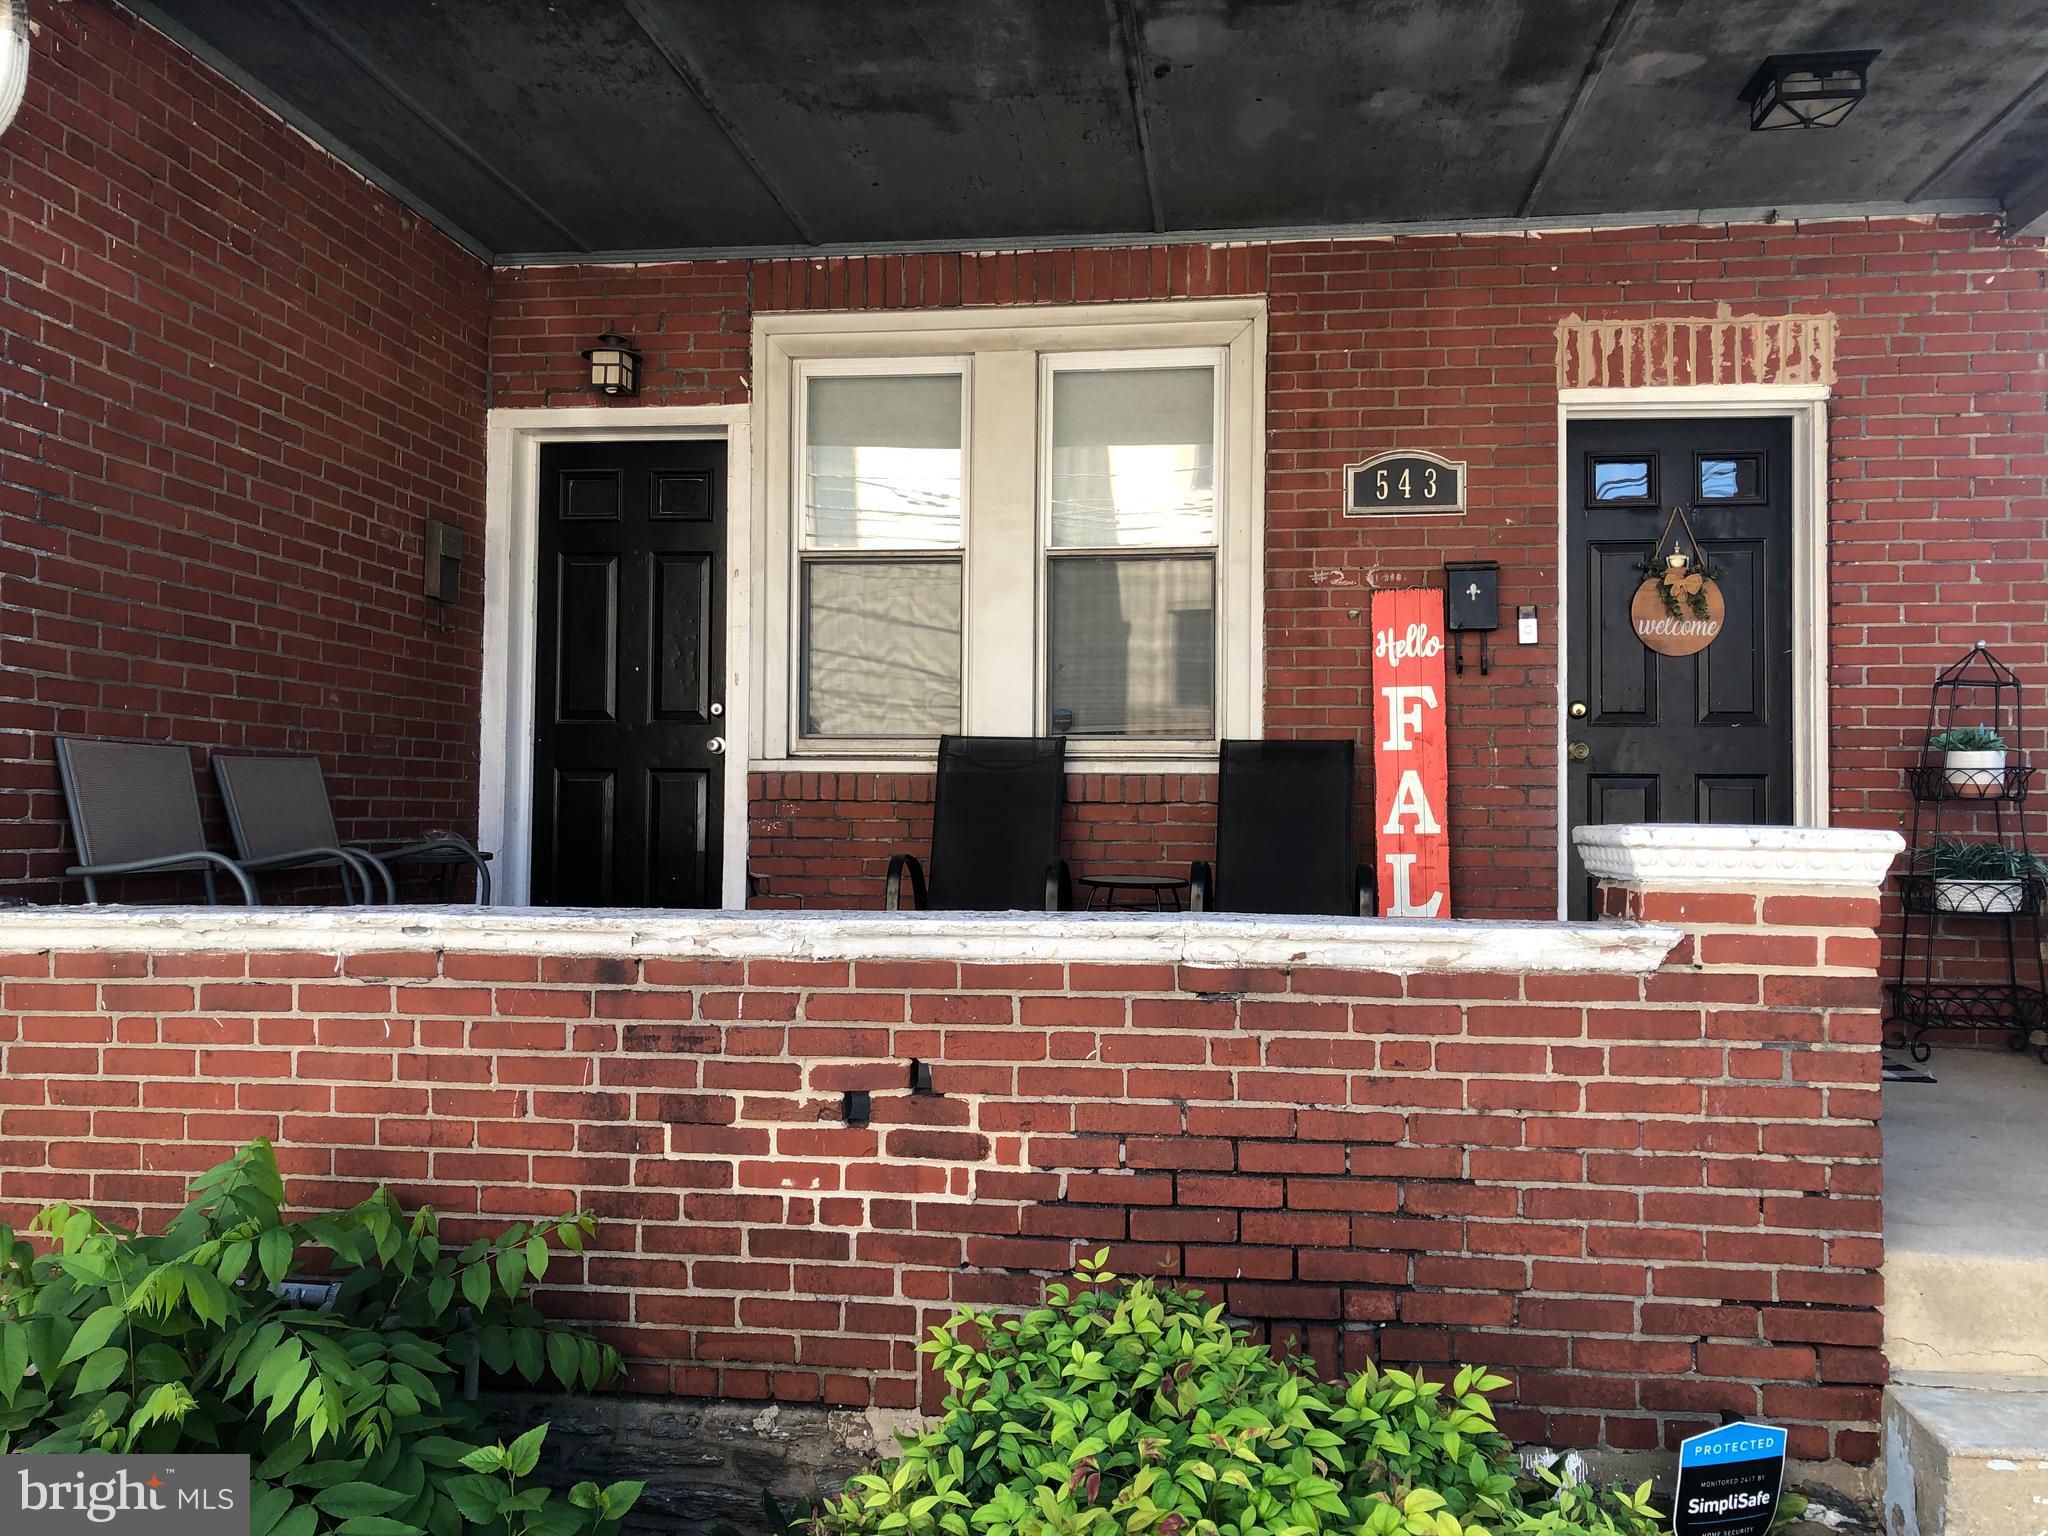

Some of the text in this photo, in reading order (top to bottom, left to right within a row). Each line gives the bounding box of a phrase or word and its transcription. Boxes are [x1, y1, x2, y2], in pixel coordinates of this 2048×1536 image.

[1376, 468, 1437, 500] 543
[1639, 616, 1720, 636] welcome
[1375, 623, 1445, 667] Hello
[1695, 1437, 1774, 1456] PROTECTED
[1700, 1478, 1739, 1488] MONITORED
[1757, 1474, 1766, 1482] BY
[1687, 1490, 1771, 1515] SimpliSafe
[1723, 1526, 1754, 1536] SECURITY
